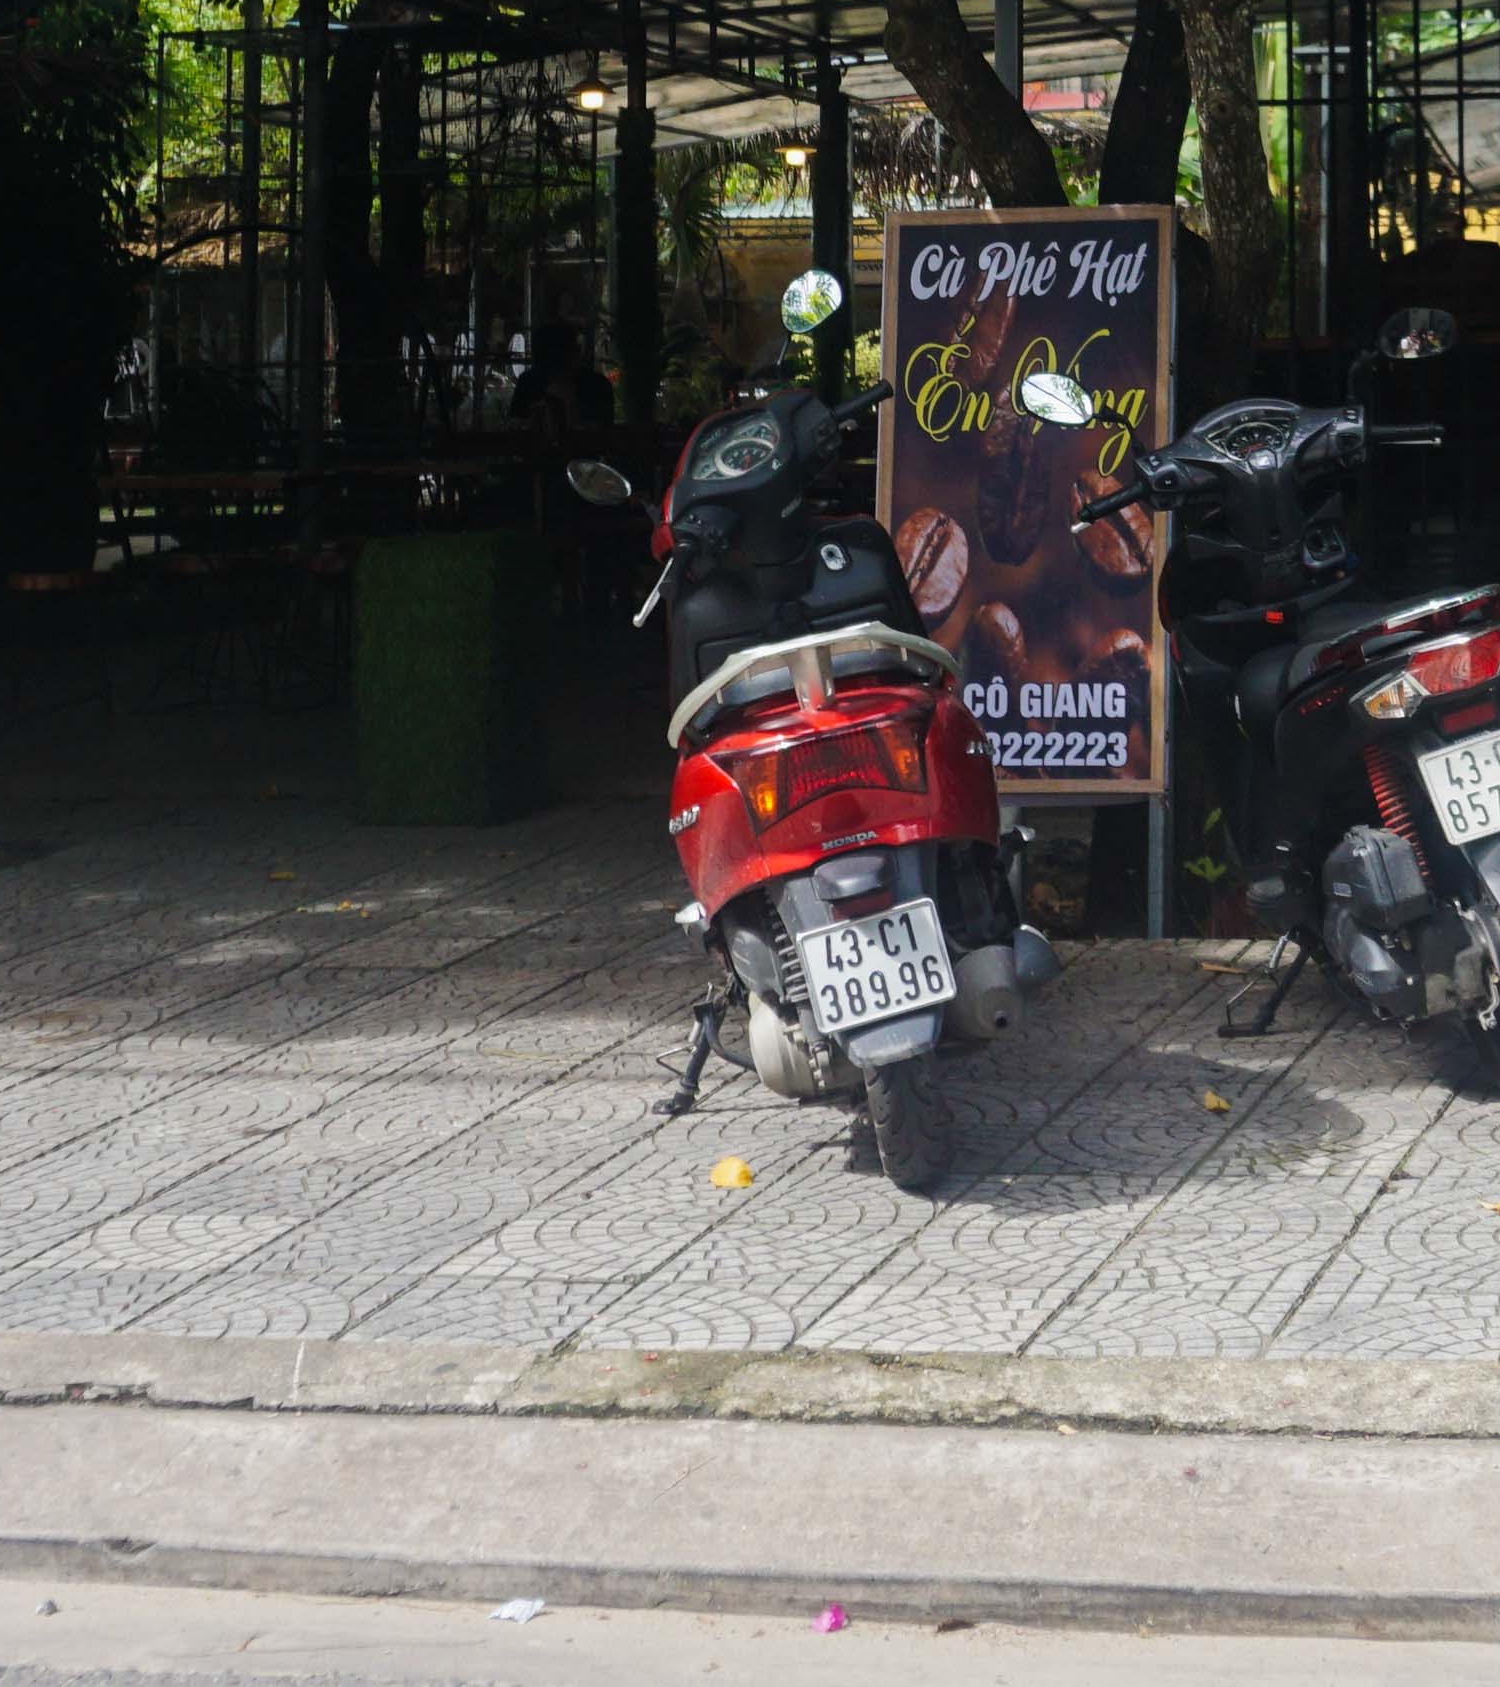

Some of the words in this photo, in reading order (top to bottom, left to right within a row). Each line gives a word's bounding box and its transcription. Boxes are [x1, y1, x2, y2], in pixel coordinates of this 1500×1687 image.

[910, 243, 966, 300] Cà
[978, 241, 1061, 302] Phê
[1068, 239, 1148, 306] Hạt
[905, 315, 996, 442] Én
[963, 675, 1008, 719] CÔ
[1020, 682, 1126, 718] GIANG
[822, 830, 879, 851] HONDA
[820, 955, 944, 1023] 389.96
